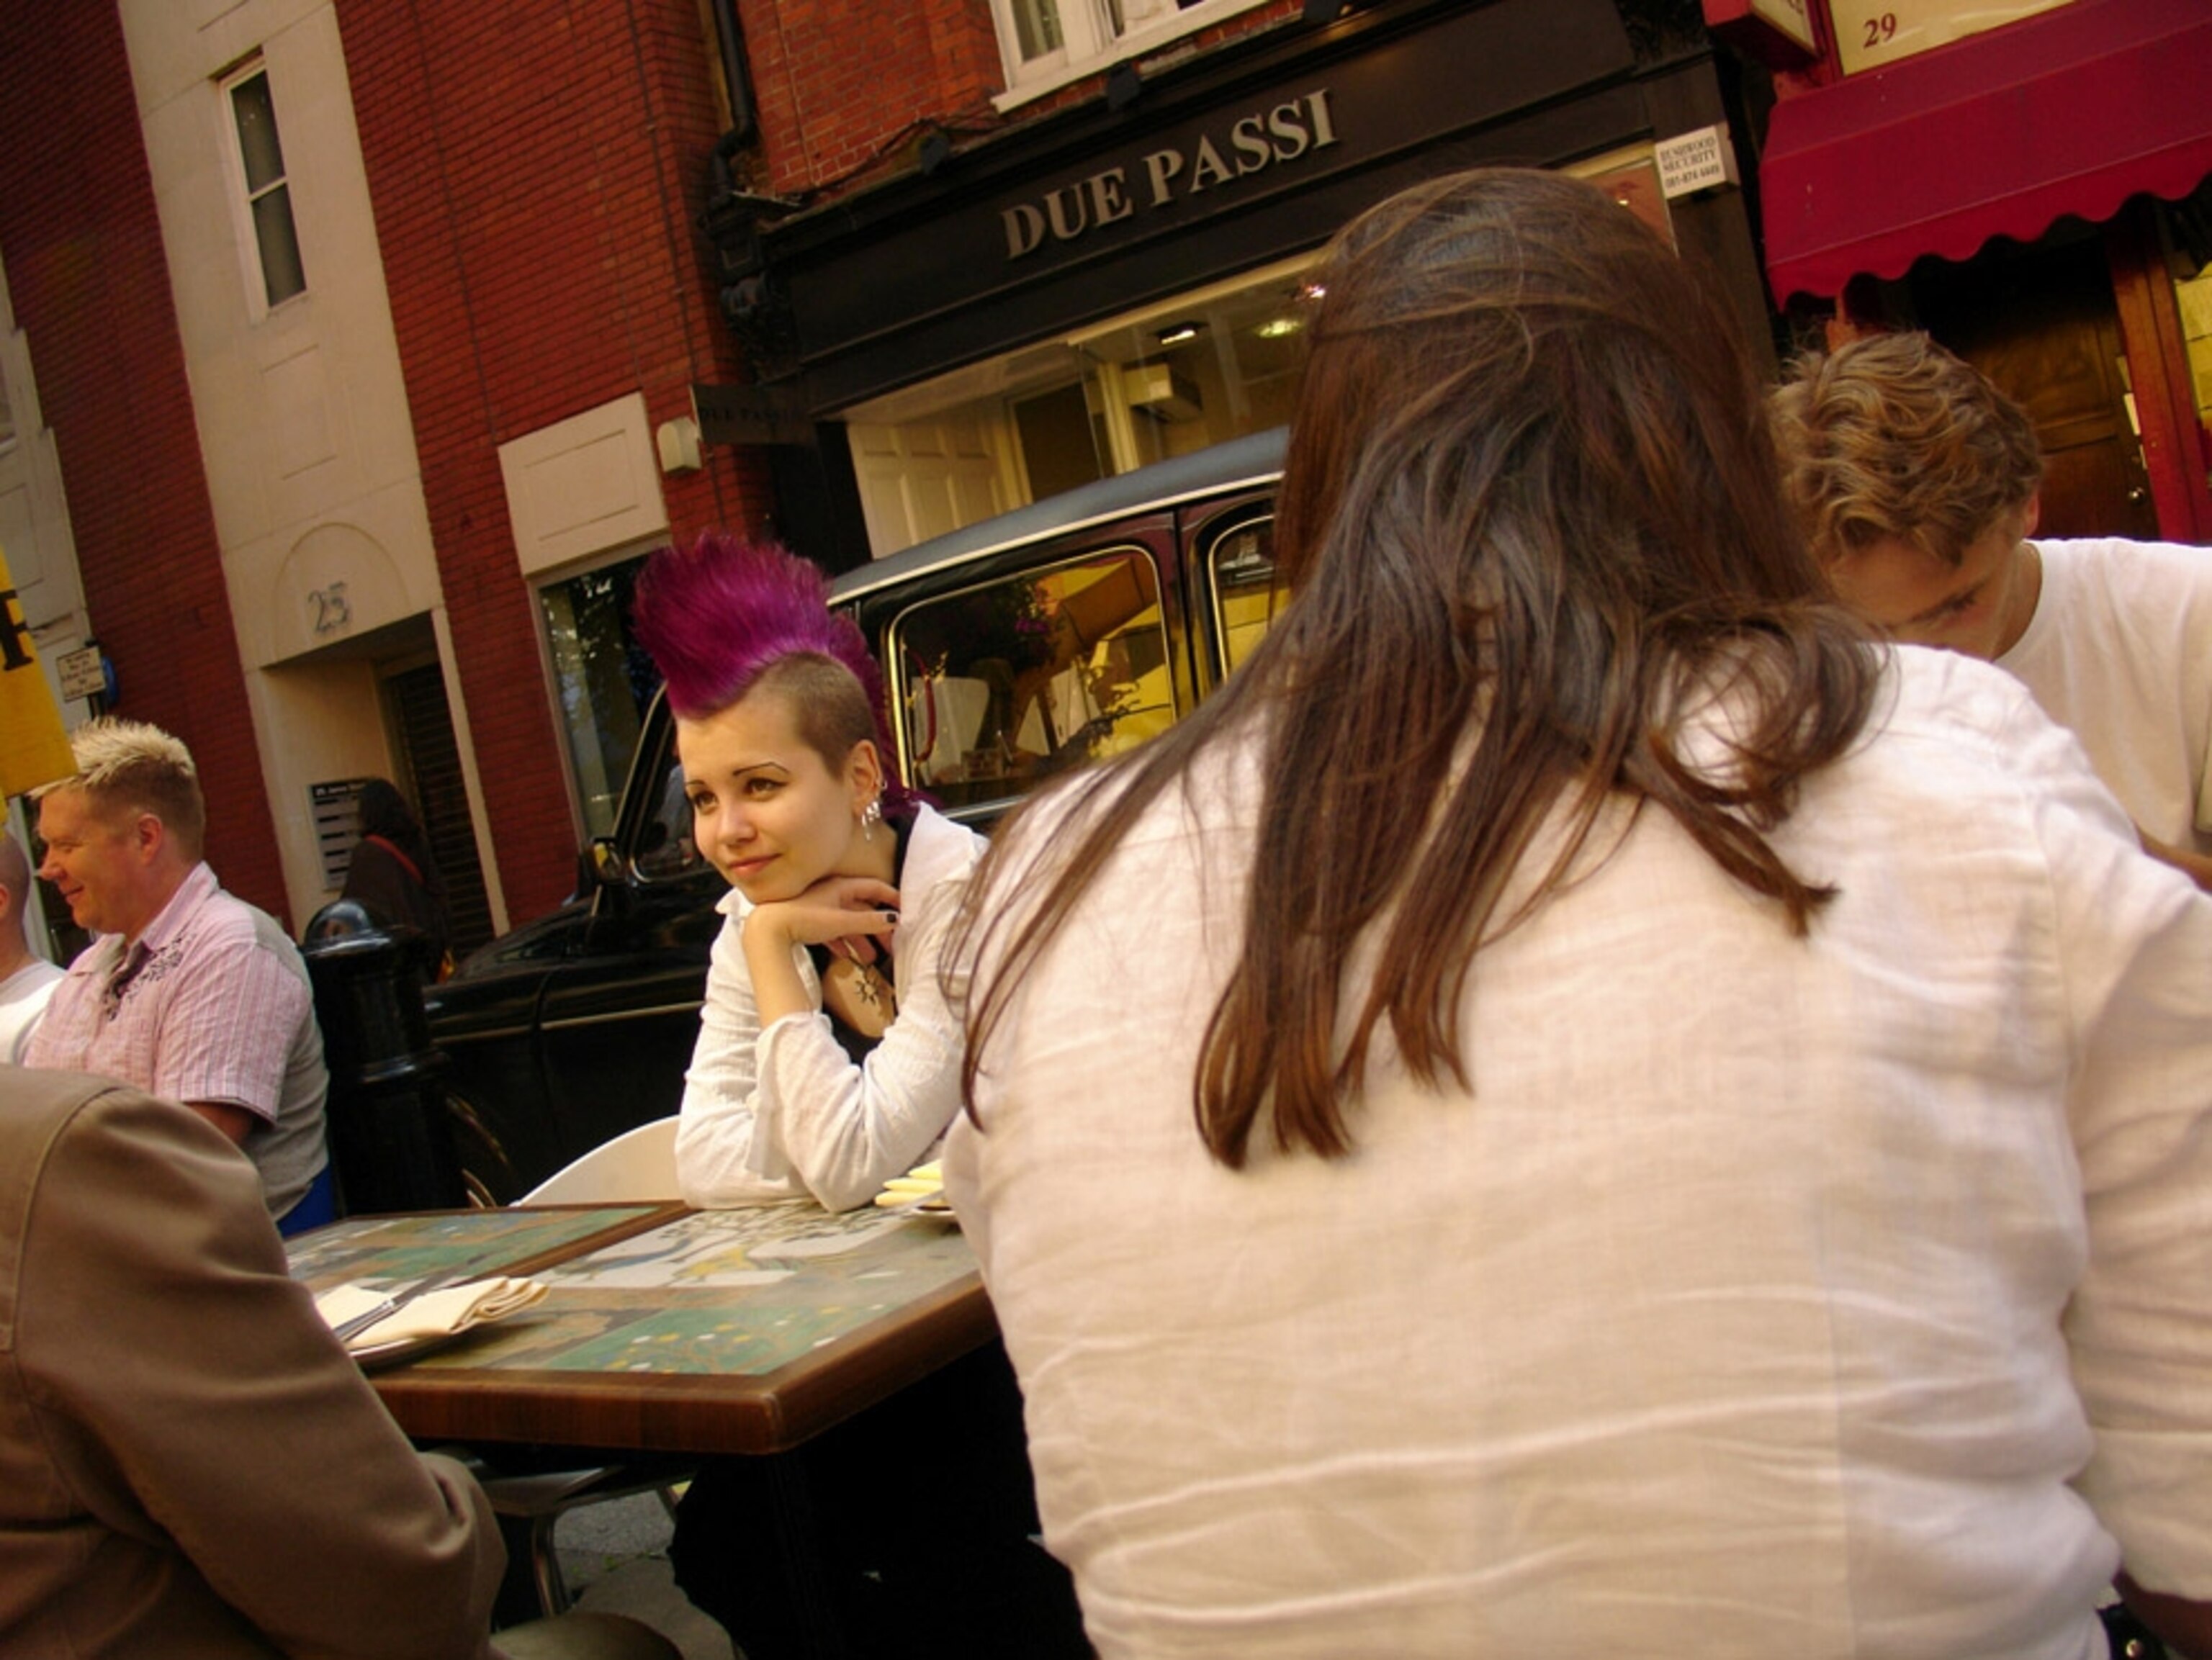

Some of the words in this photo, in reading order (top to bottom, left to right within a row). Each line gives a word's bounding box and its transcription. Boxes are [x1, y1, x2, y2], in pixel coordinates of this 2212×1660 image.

[1862, 12, 1897, 49] 29
[1002, 166, 1133, 259] DUE
[1142, 87, 1341, 207] PASSI
[1662, 149, 1717, 172] SECURITY
[307, 579, 351, 633] 25
